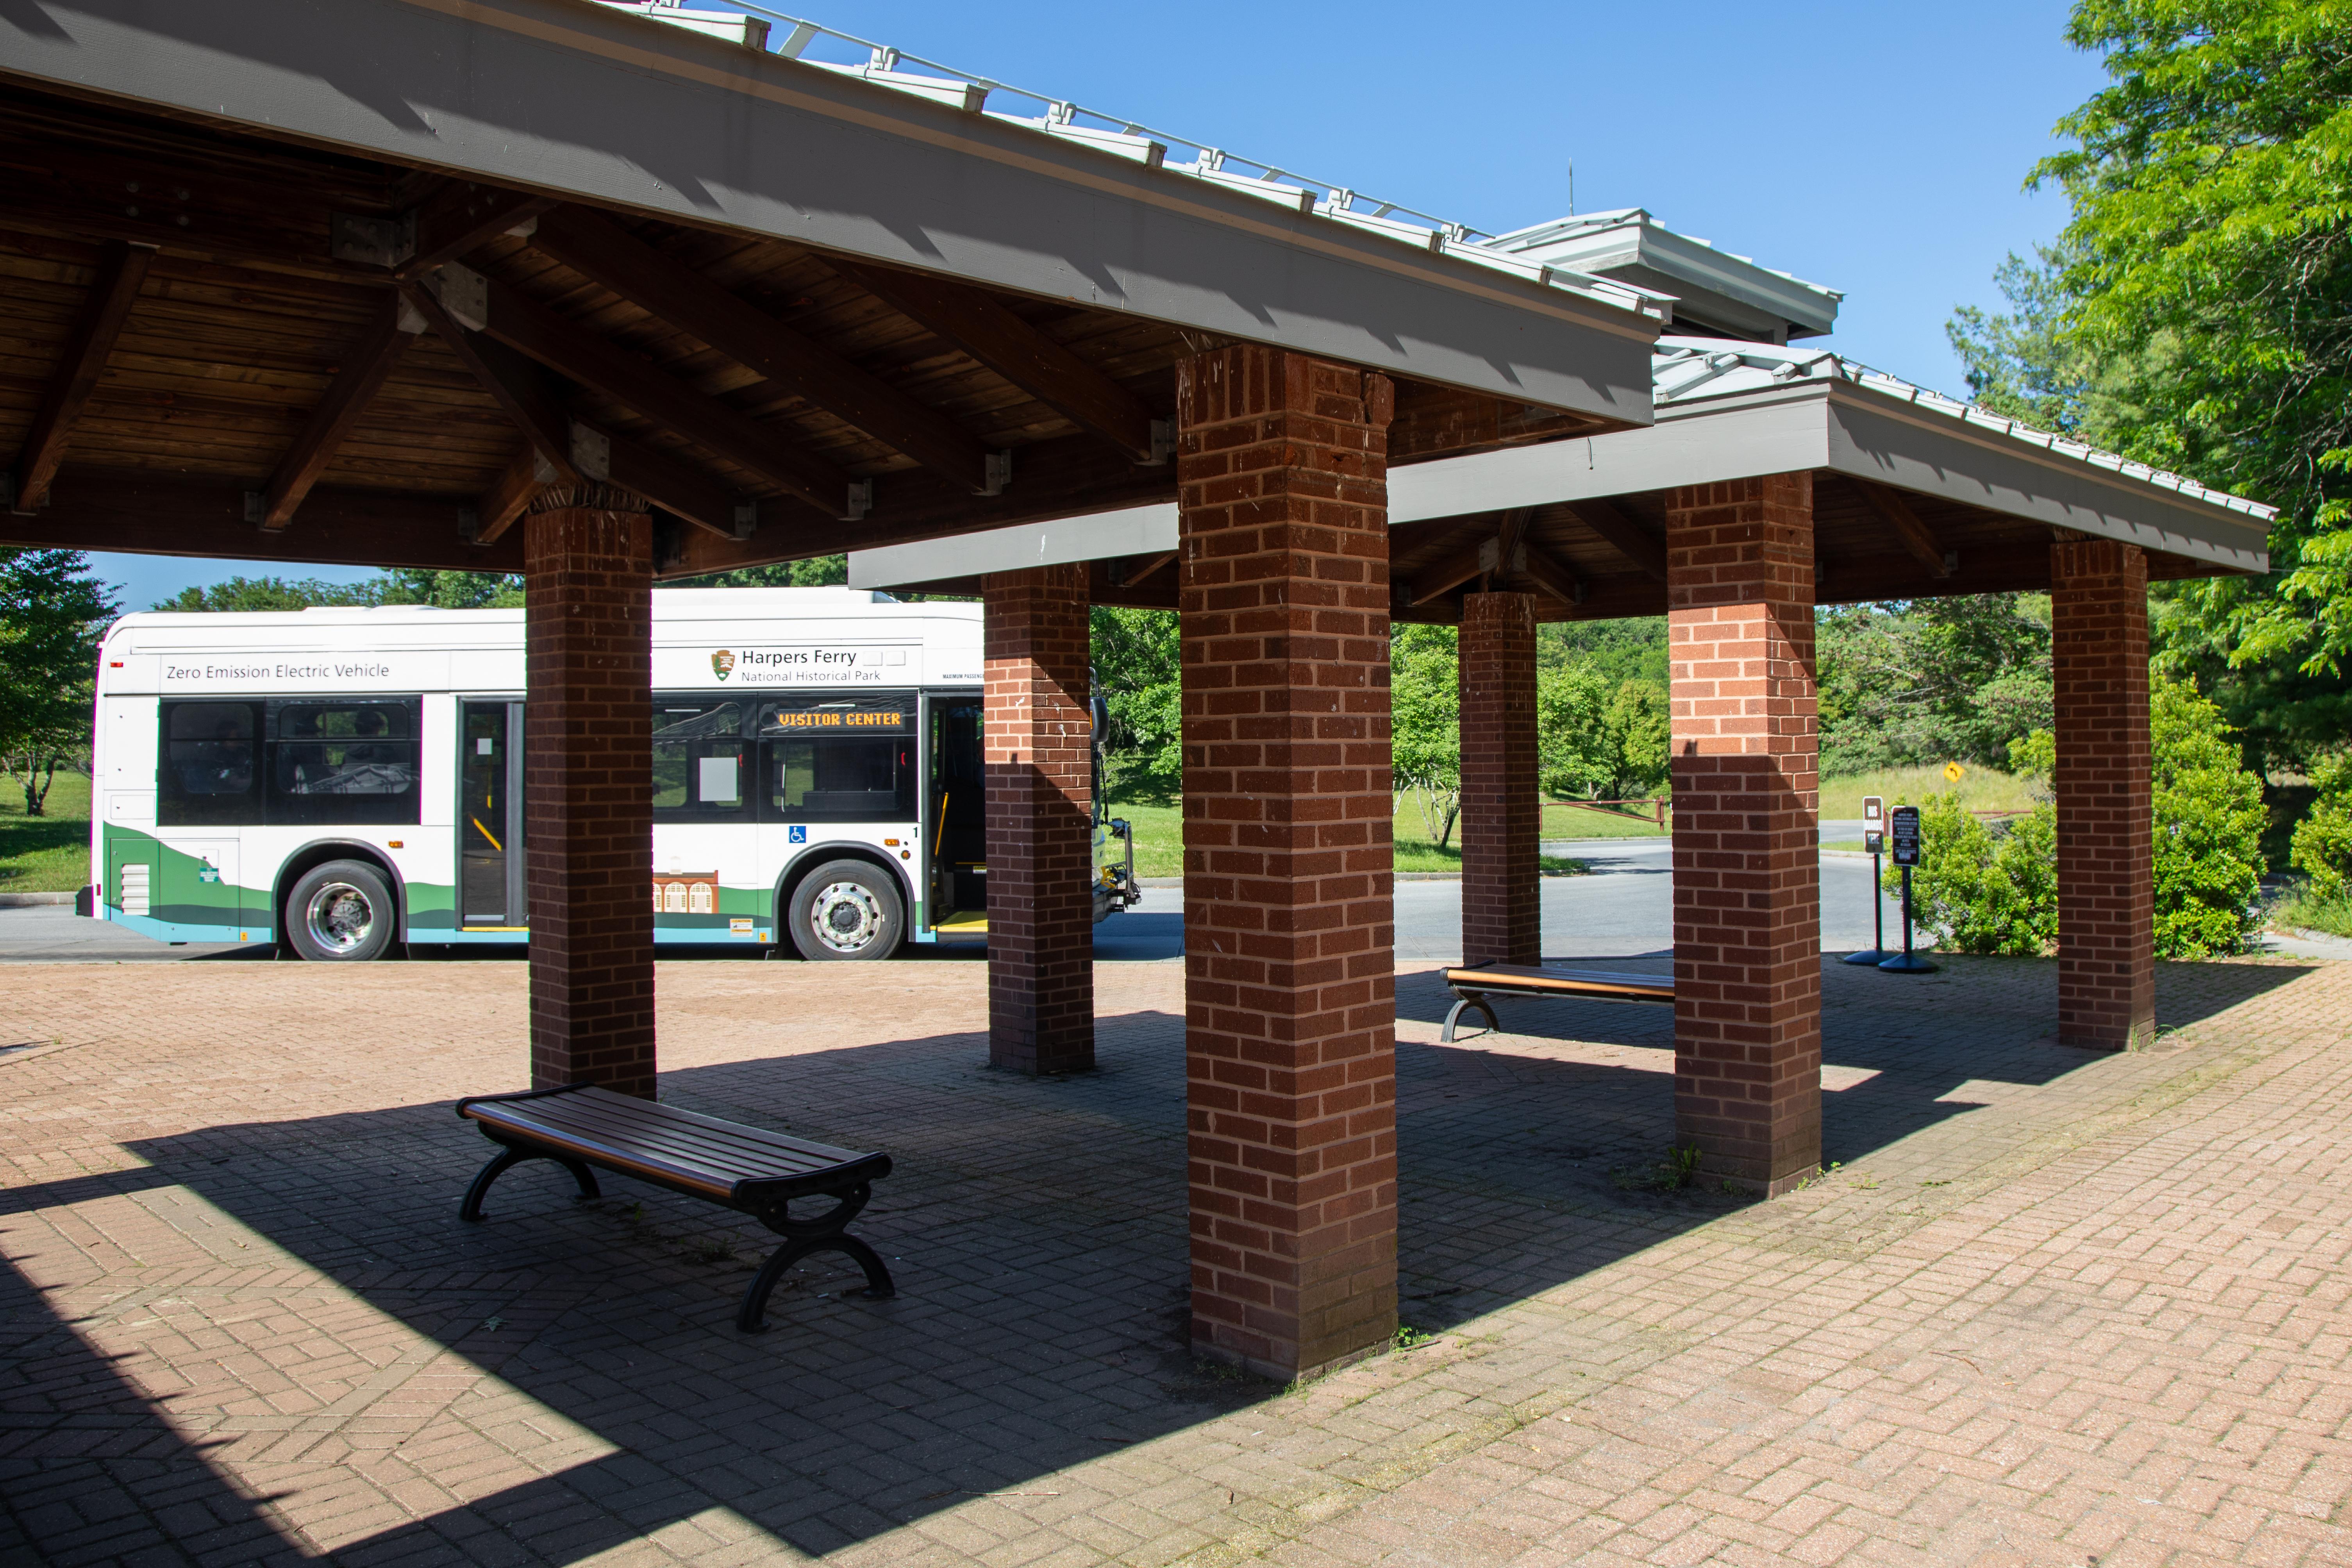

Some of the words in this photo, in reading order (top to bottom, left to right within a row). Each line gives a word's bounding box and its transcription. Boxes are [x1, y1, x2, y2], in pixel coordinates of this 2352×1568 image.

[743, 650, 807, 667] Harpers
[814, 650, 857, 666] Ferry
[167, 666, 201, 679] Zero
[207, 665, 270, 678] Emission
[276, 664, 329, 677] Electric
[335, 664, 389, 677] Vehicle
[742, 671, 791, 681] National
[797, 671, 850, 681] Historical
[855, 670, 880, 680] Park
[779, 714, 840, 726] VISITOR
[846, 713, 900, 725] CENTER
[1867, 805, 1877, 817] BUS
[1865, 819, 1882, 831] BOARDS
[913, 827, 918, 838] 1
[1867, 833, 1880, 844] HERE
